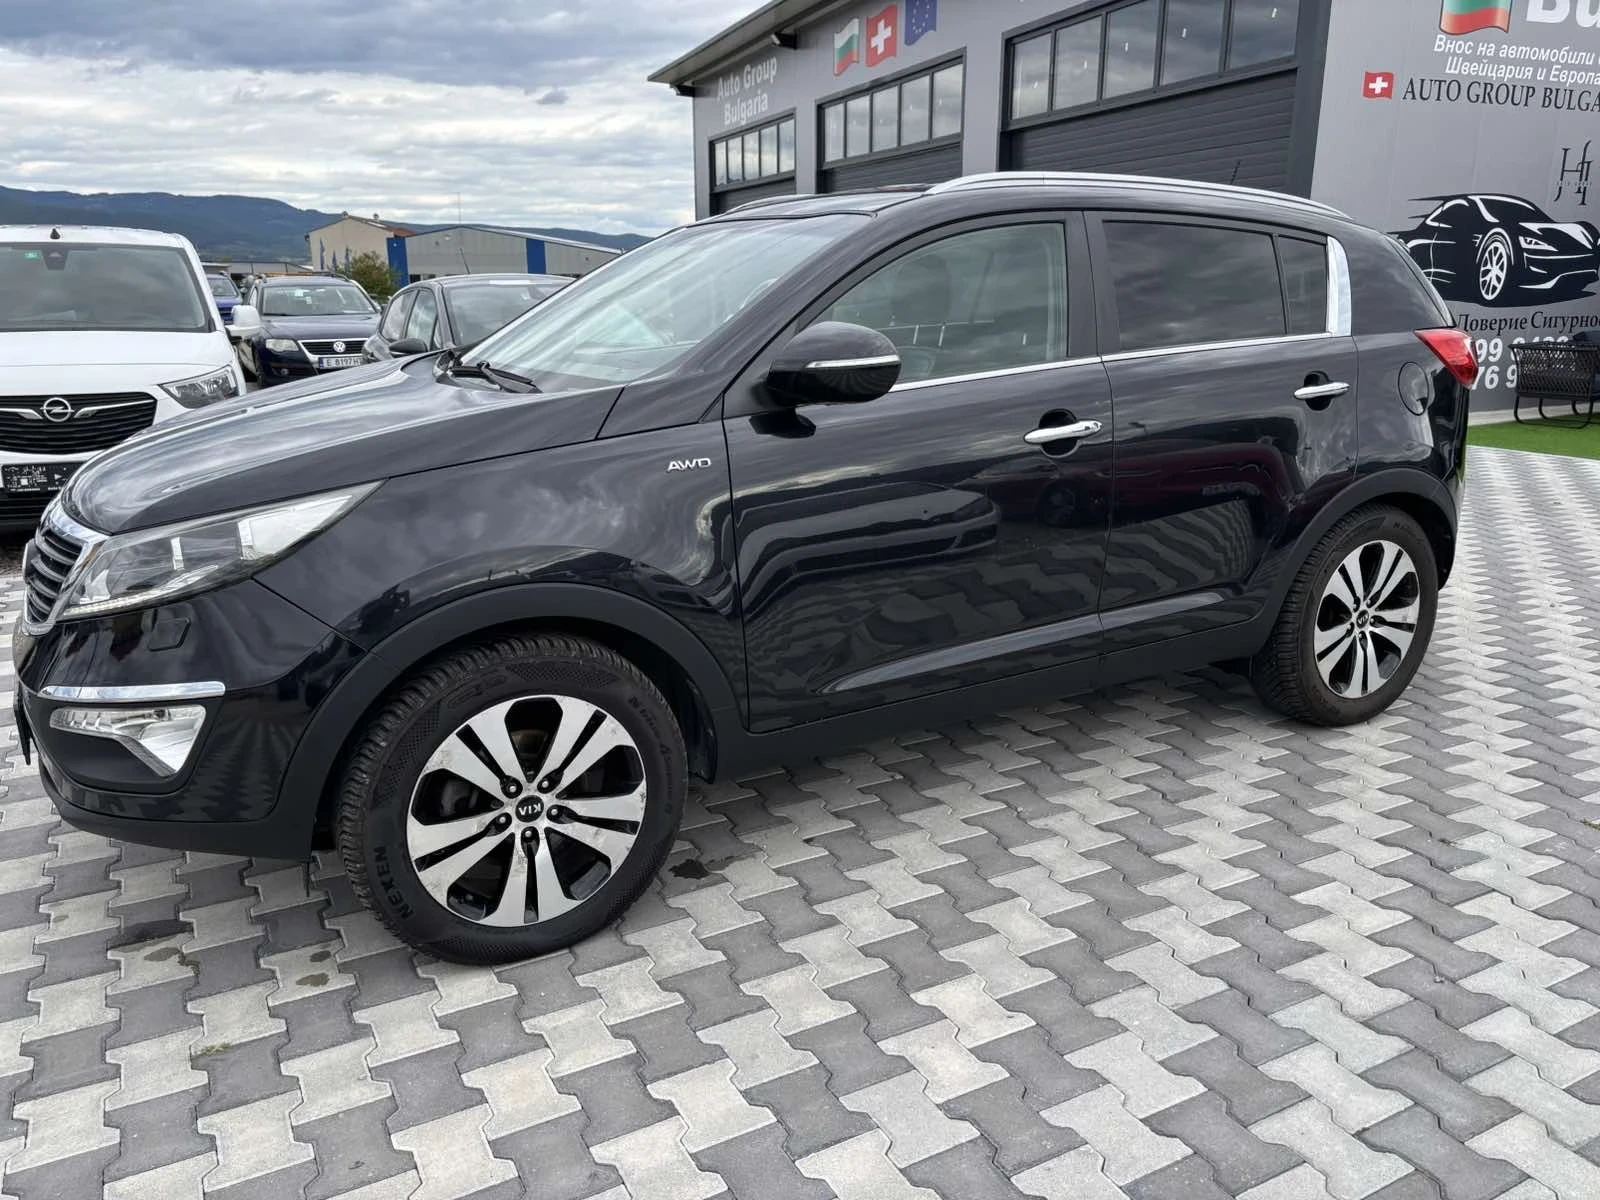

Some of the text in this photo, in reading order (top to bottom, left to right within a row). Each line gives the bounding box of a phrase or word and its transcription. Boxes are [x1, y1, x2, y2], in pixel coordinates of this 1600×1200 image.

[1434, 34, 1596, 65] Внос на автомобили
[717, 56, 777, 102] Auto Group
[1445, 56, 1533, 81] Швейцария
[1537, 67, 1547, 81] и
[724, 88, 768, 126] Bulgaria
[1402, 77, 1462, 102] AUTO
[1466, 80, 1536, 107] GROUP
[1530, 311, 1600, 334] Сигурно
[667, 457, 712, 471] AWD
[518, 802, 542, 816] KIA
[373, 845, 416, 919] NEXEN
